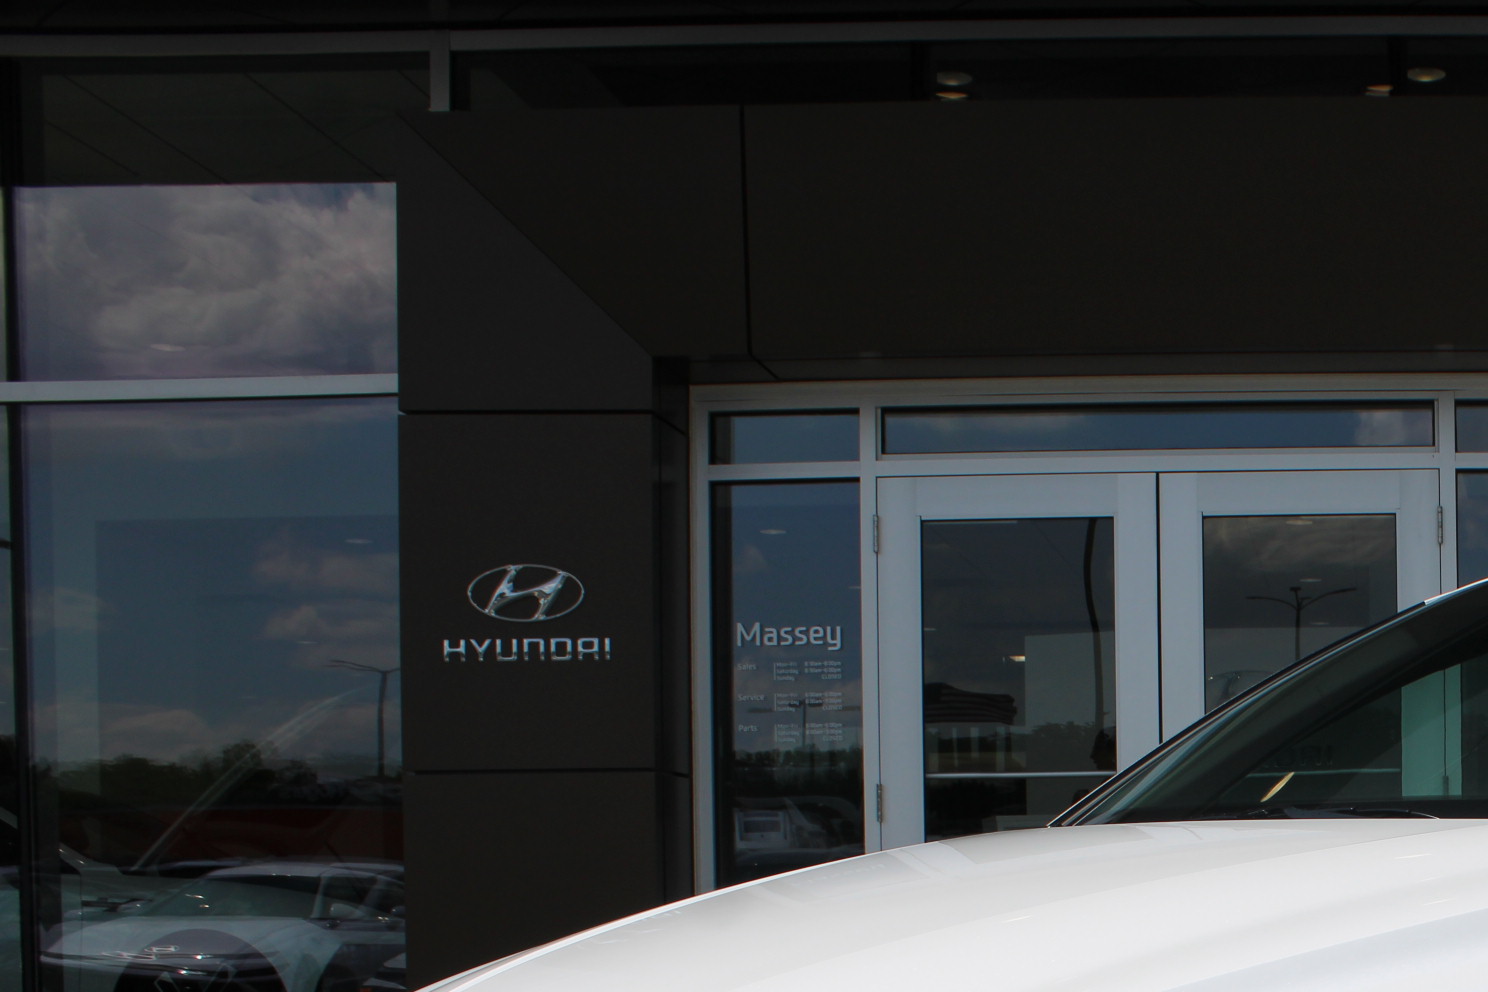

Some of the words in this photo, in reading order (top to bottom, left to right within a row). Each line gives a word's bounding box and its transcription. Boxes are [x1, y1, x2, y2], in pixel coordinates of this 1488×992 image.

[736, 622, 842, 651] Massey
[443, 637, 611, 662] HYUNDAI
[737, 663, 757, 671] Sales
[738, 724, 758, 732] Parts
